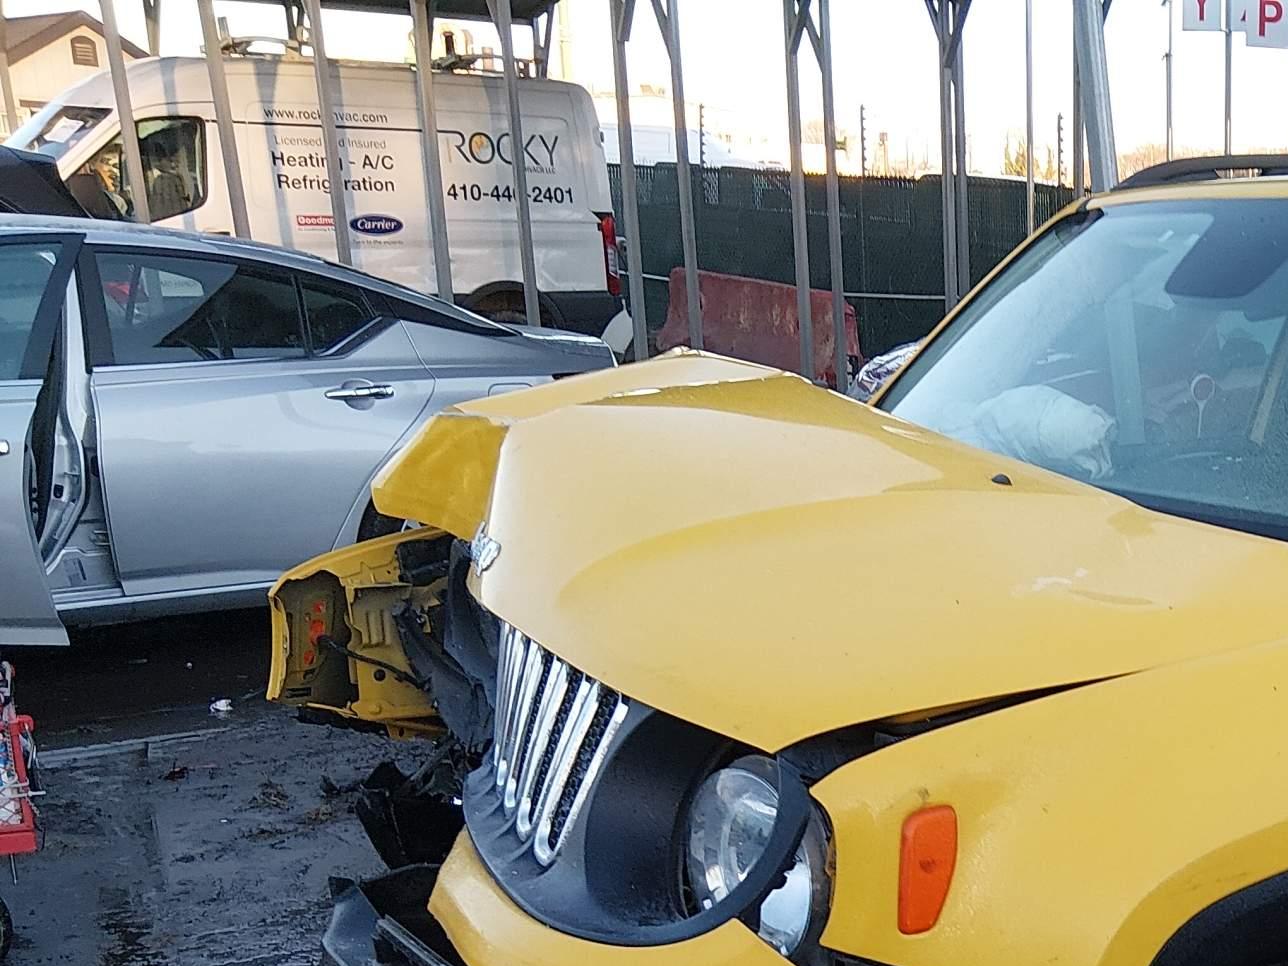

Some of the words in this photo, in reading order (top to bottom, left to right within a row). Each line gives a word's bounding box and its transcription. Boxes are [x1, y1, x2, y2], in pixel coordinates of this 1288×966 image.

[274, 135, 322, 147] Licensed
[348, 137, 386, 149] Insured
[271, 150, 343, 171] Heatin
[362, 153, 394, 170] A/C
[277, 173, 395, 194] Refrigration
[447, 183, 574, 203] 410-44-2401
[357, 216, 397, 230] Carrier
